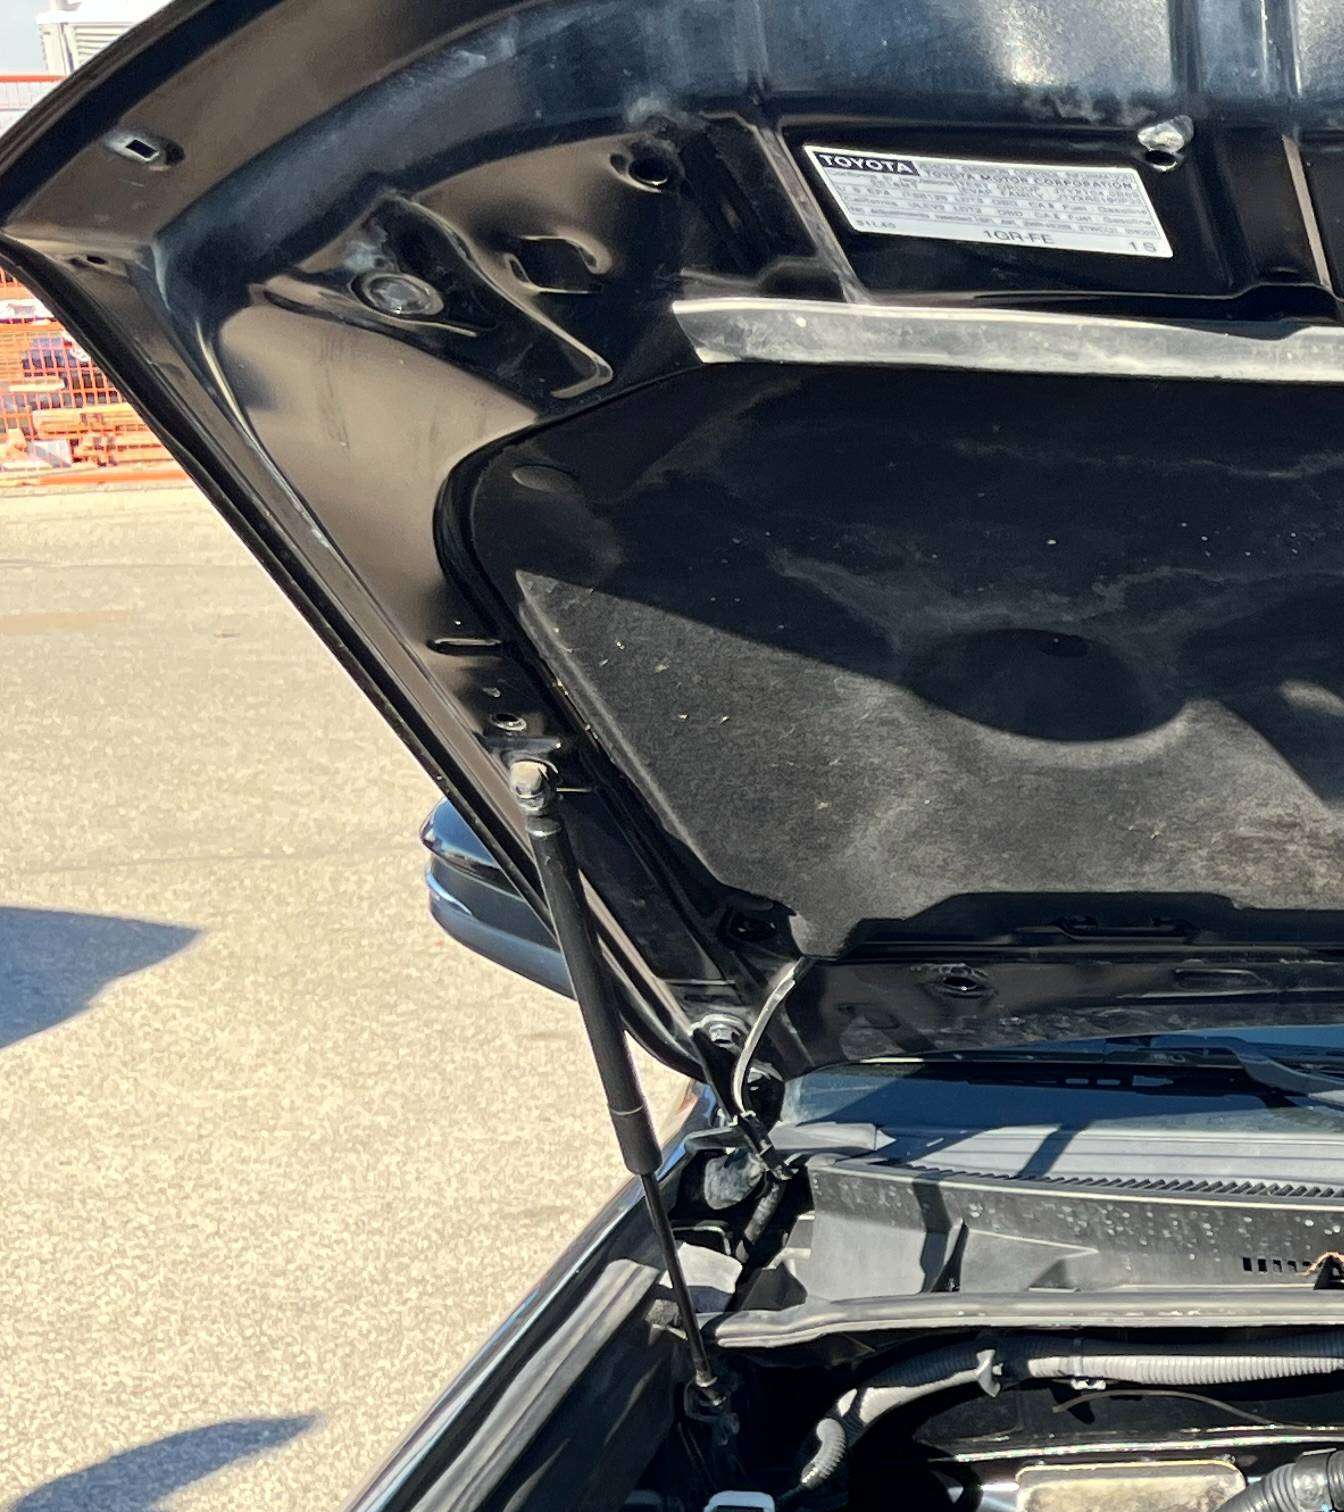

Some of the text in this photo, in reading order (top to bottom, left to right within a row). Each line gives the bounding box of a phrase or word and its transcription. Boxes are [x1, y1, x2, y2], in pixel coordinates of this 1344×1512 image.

[818, 154, 913, 174] TOYOTA
[980, 173, 1028, 184] MOTOR
[1034, 177, 1133, 189] CORPORATION
[983, 229, 1054, 244] 1GR-FE
